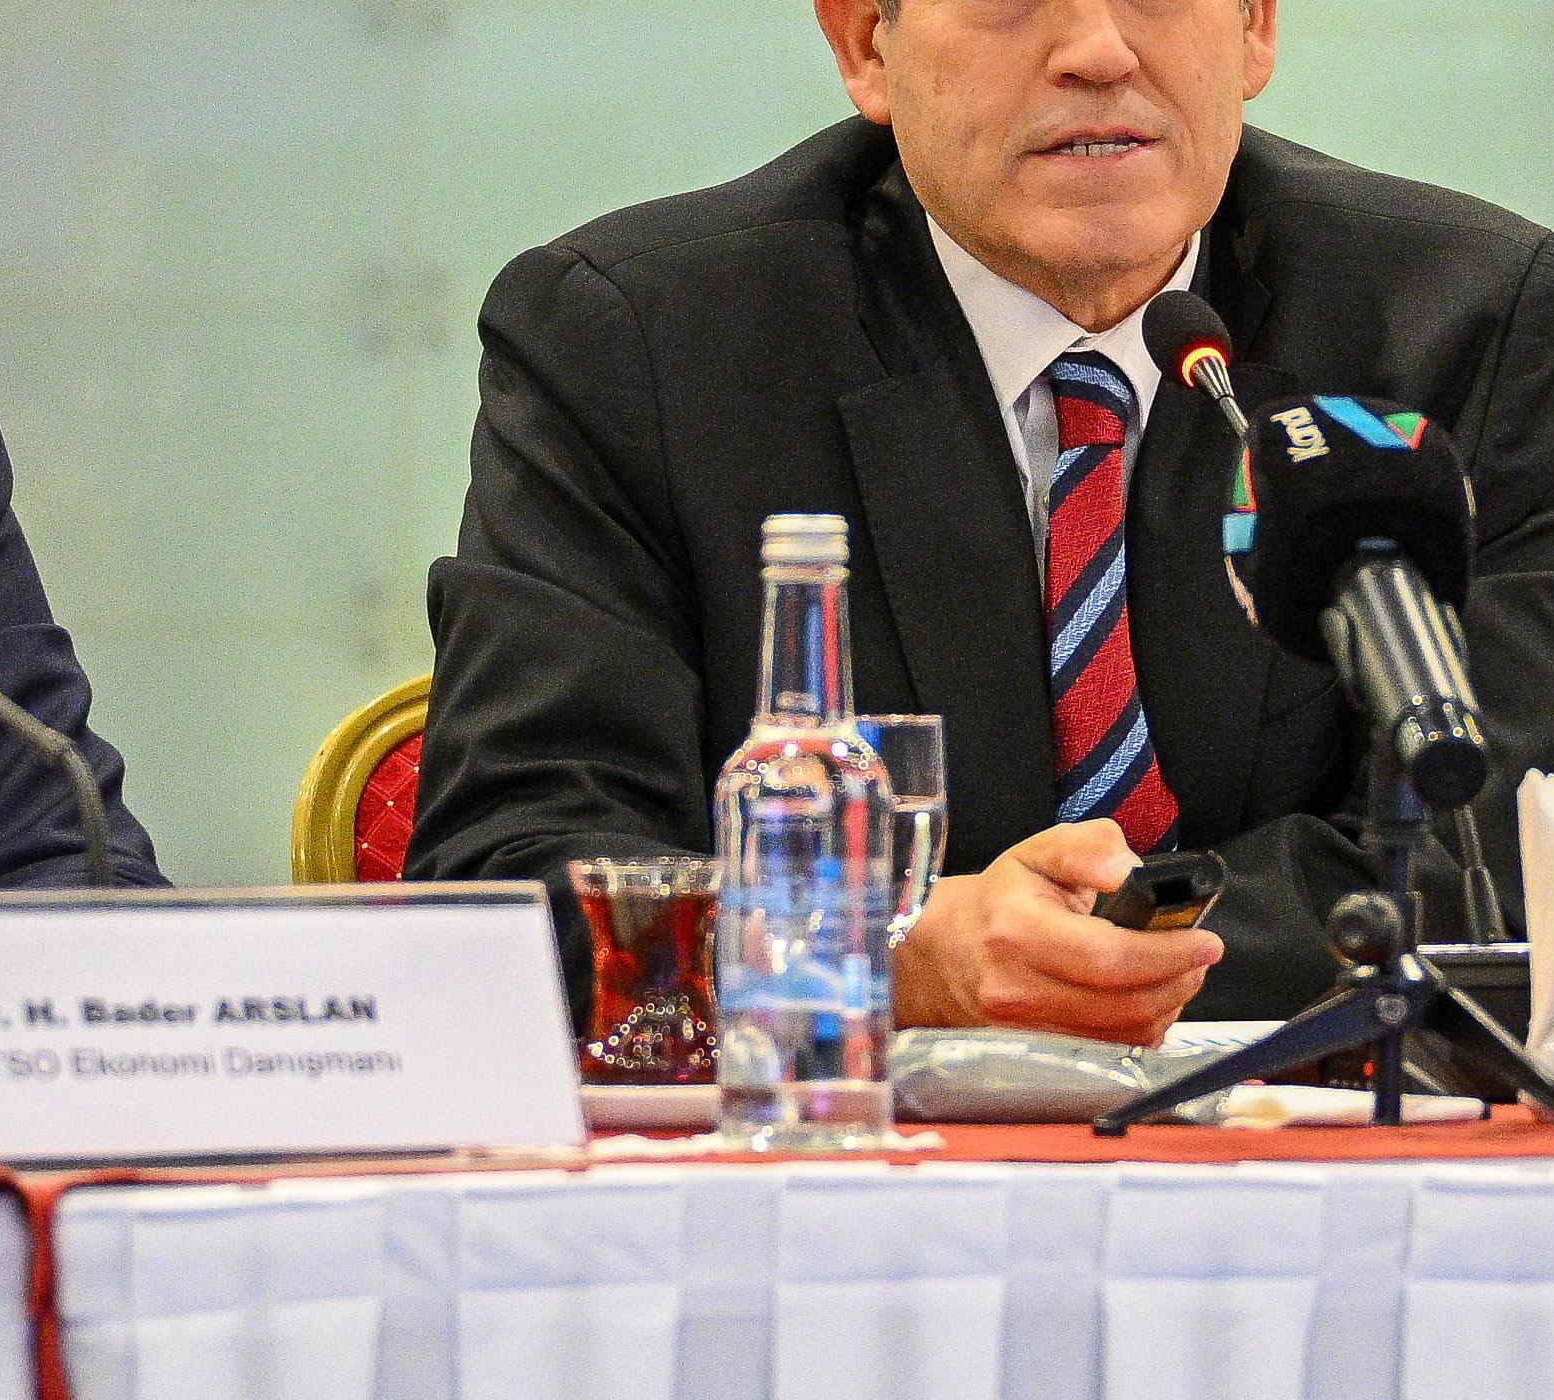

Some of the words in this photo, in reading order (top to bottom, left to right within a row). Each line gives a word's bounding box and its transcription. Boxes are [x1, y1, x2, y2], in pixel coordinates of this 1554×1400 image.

[21, 998, 68, 1028] H.
[211, 994, 379, 1026] ARSLAN
[68, 1046, 216, 1079] Ekonomi
